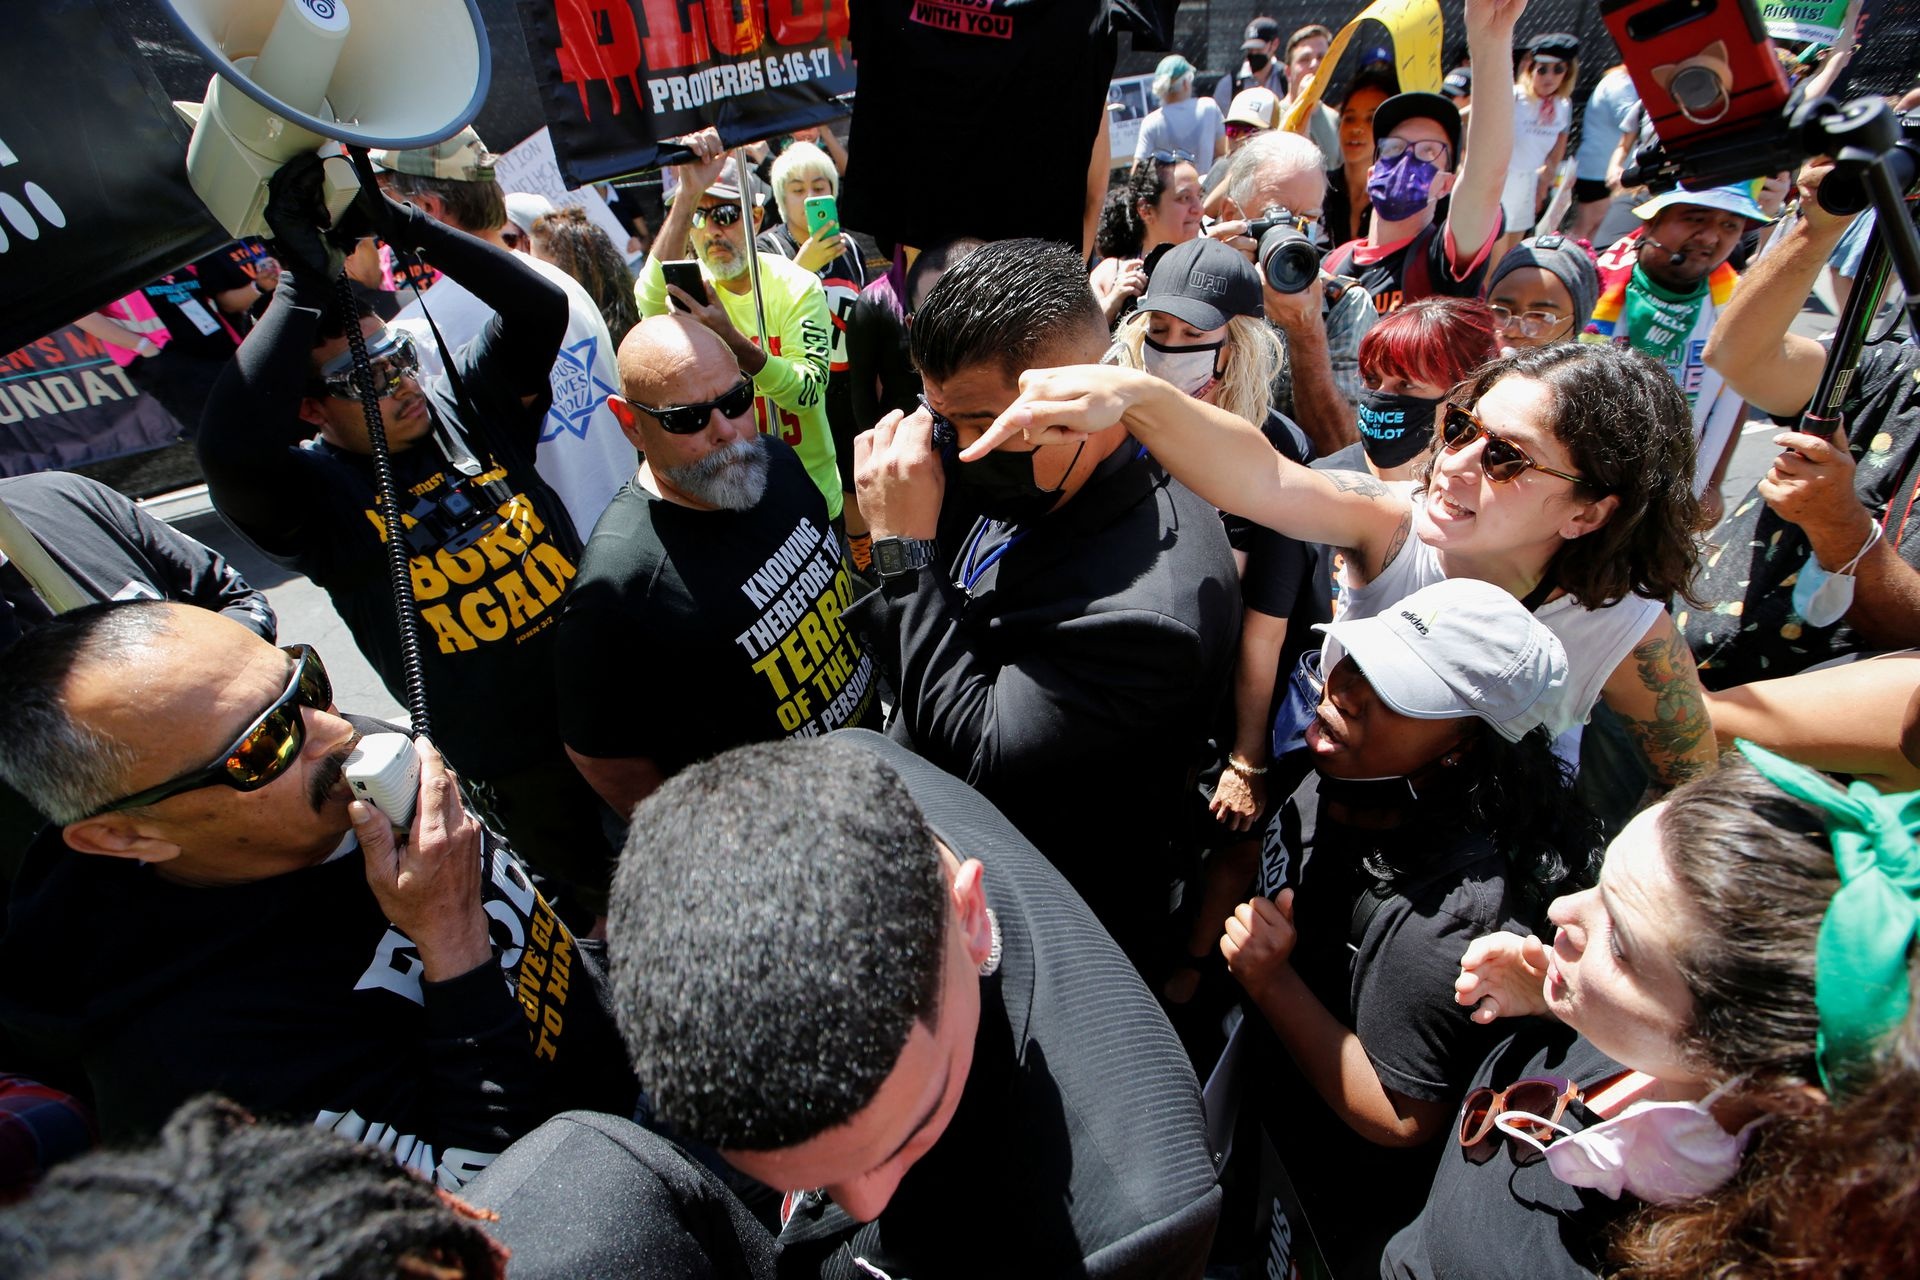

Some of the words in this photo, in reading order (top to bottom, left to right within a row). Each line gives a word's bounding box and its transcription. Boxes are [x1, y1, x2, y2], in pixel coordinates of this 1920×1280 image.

[916, 4, 960, 29] WITH
[966, 12, 1010, 36] YOU
[1762, 4, 1826, 20] Rights!
[648, 59, 765, 114] PROVERBS
[765, 47, 831, 88] 6:16-17
[560, 391, 585, 416] YOU
[408, 493, 545, 602] BORN
[741, 516, 822, 611] KNOWING
[420, 542, 577, 654] AGAIN
[735, 551, 834, 660] THEREFORE
[822, 524, 841, 565] TH
[752, 555, 854, 700] TERRO
[1401, 610, 1429, 635] adidas
[515, 625, 541, 645] JOHN
[776, 687, 812, 732] OF
[812, 643, 854, 702] THE
[518, 948, 548, 1025] GIVE
[546, 922, 573, 1007] HIM
[535, 1004, 563, 1062] TO
